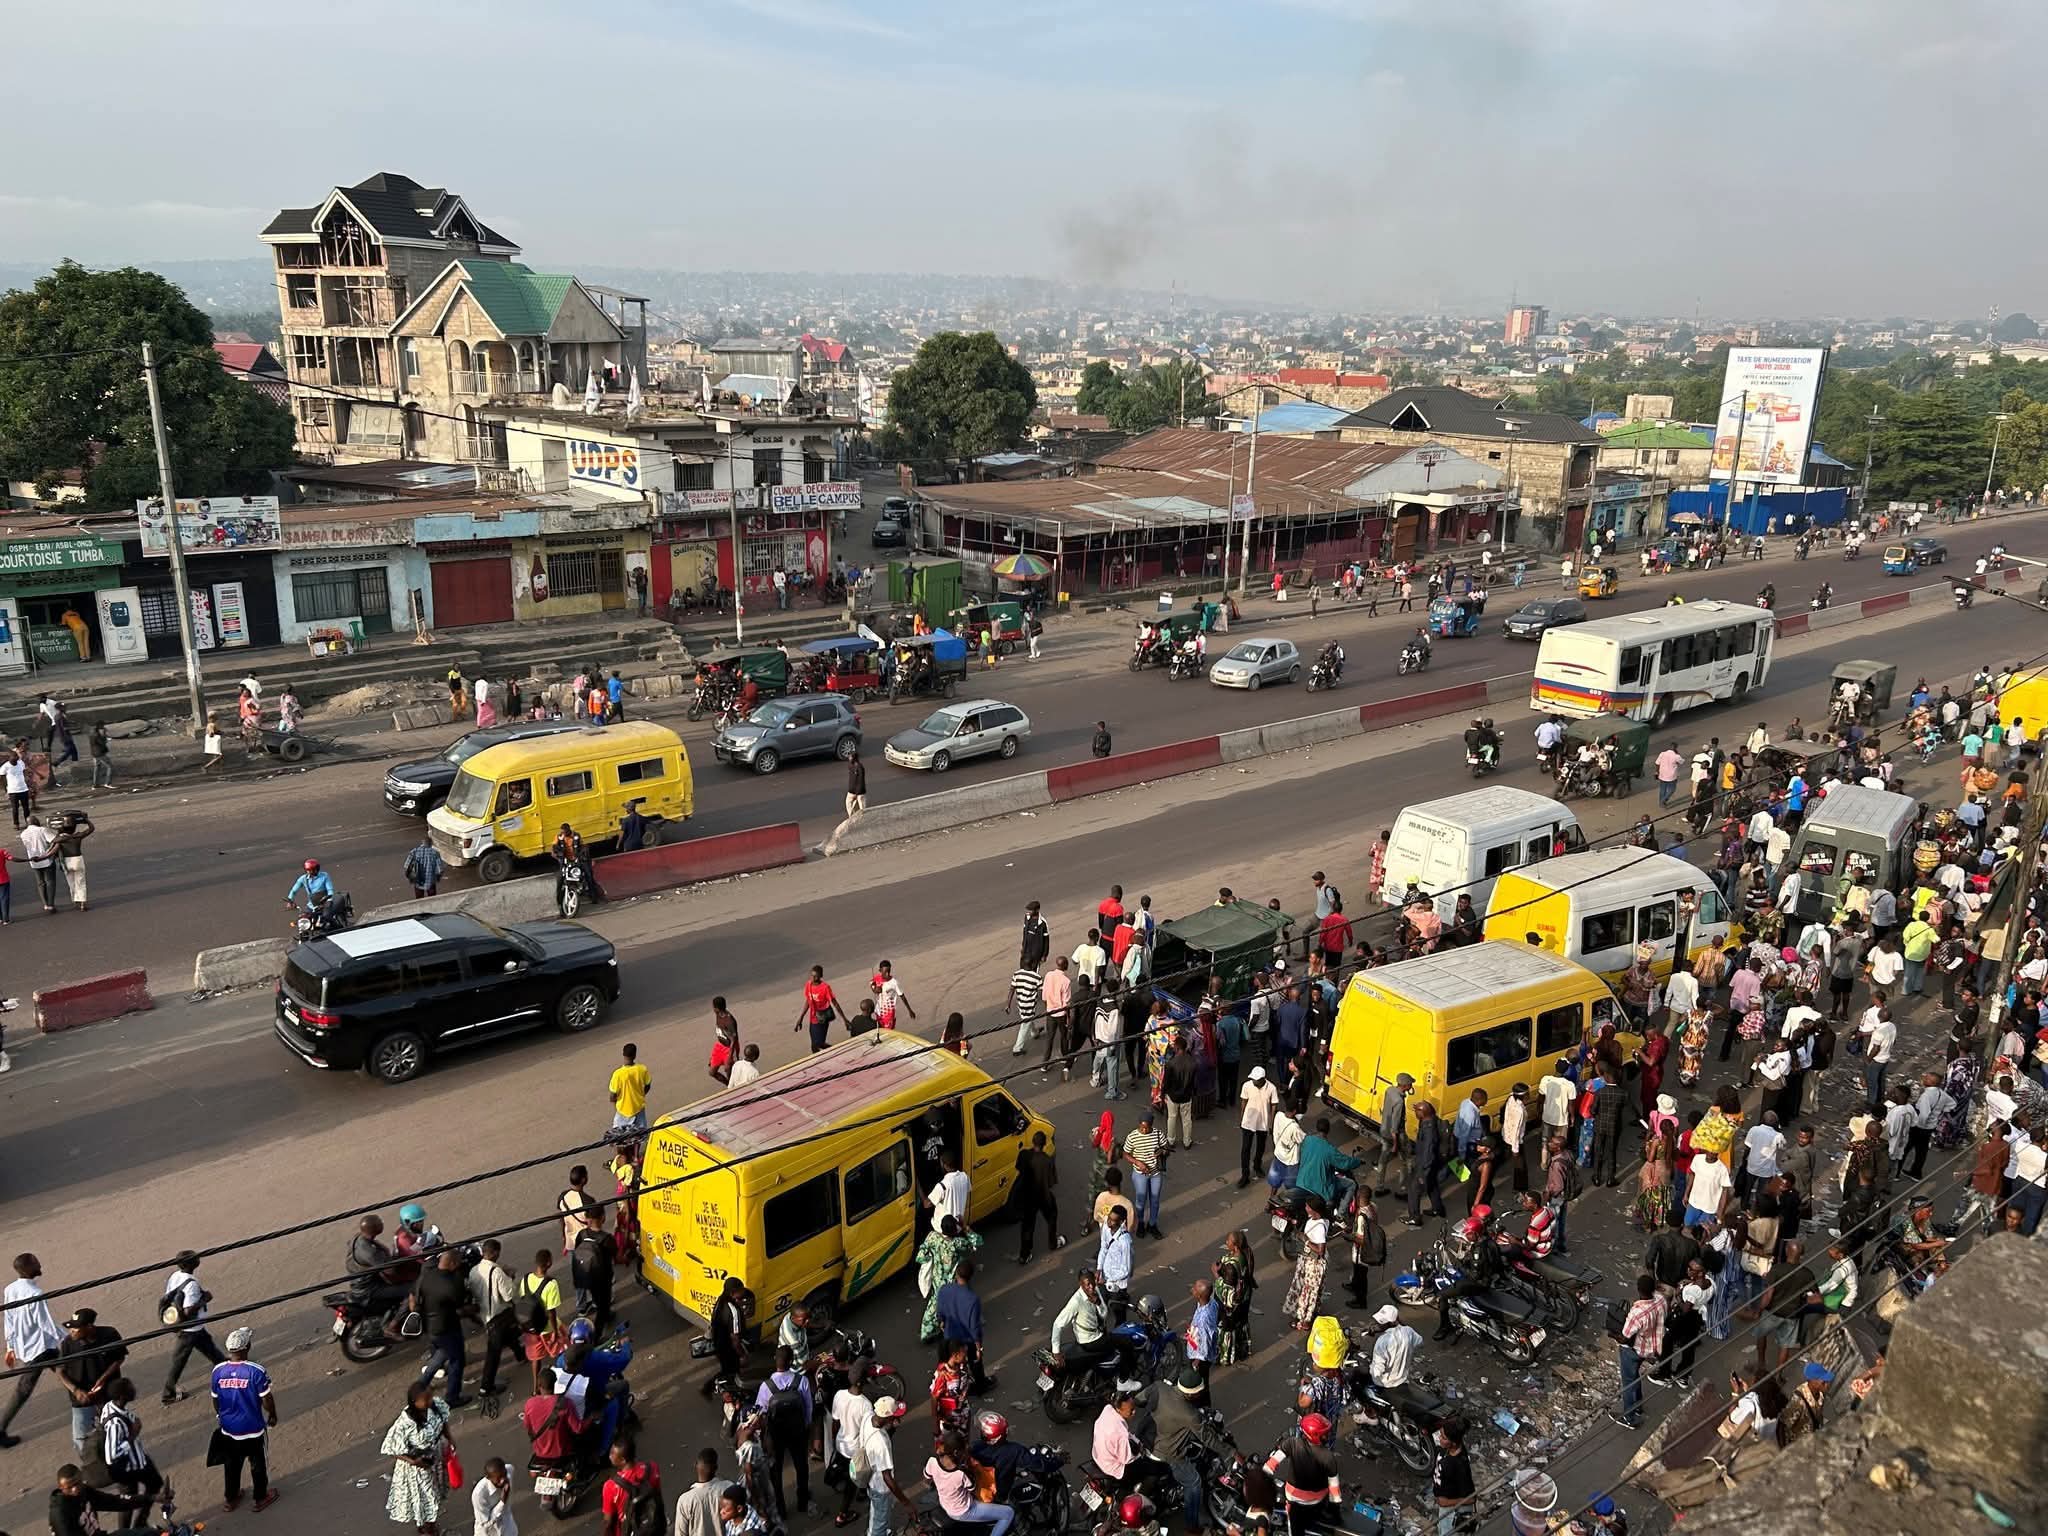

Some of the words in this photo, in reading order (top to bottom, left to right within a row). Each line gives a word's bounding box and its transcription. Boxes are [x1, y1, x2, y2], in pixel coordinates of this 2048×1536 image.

[570, 441, 638, 485] UDPS
[773, 486, 802, 496] CLINIQUE
[806, 484, 816, 494] DE
[774, 495, 816, 507] BELLE
[818, 493, 860, 505] CAMPUS
[0, 551, 63, 570] COURTOISIE
[69, 548, 105, 564] TUMBA
[1408, 821, 1447, 838] manager
[661, 1200, 681, 1216] BERGER
[702, 1201, 709, 1214] JE
[711, 1202, 719, 1216] NE
[701, 1226, 708, 1240] DE
[702, 1266, 728, 1281] 312
